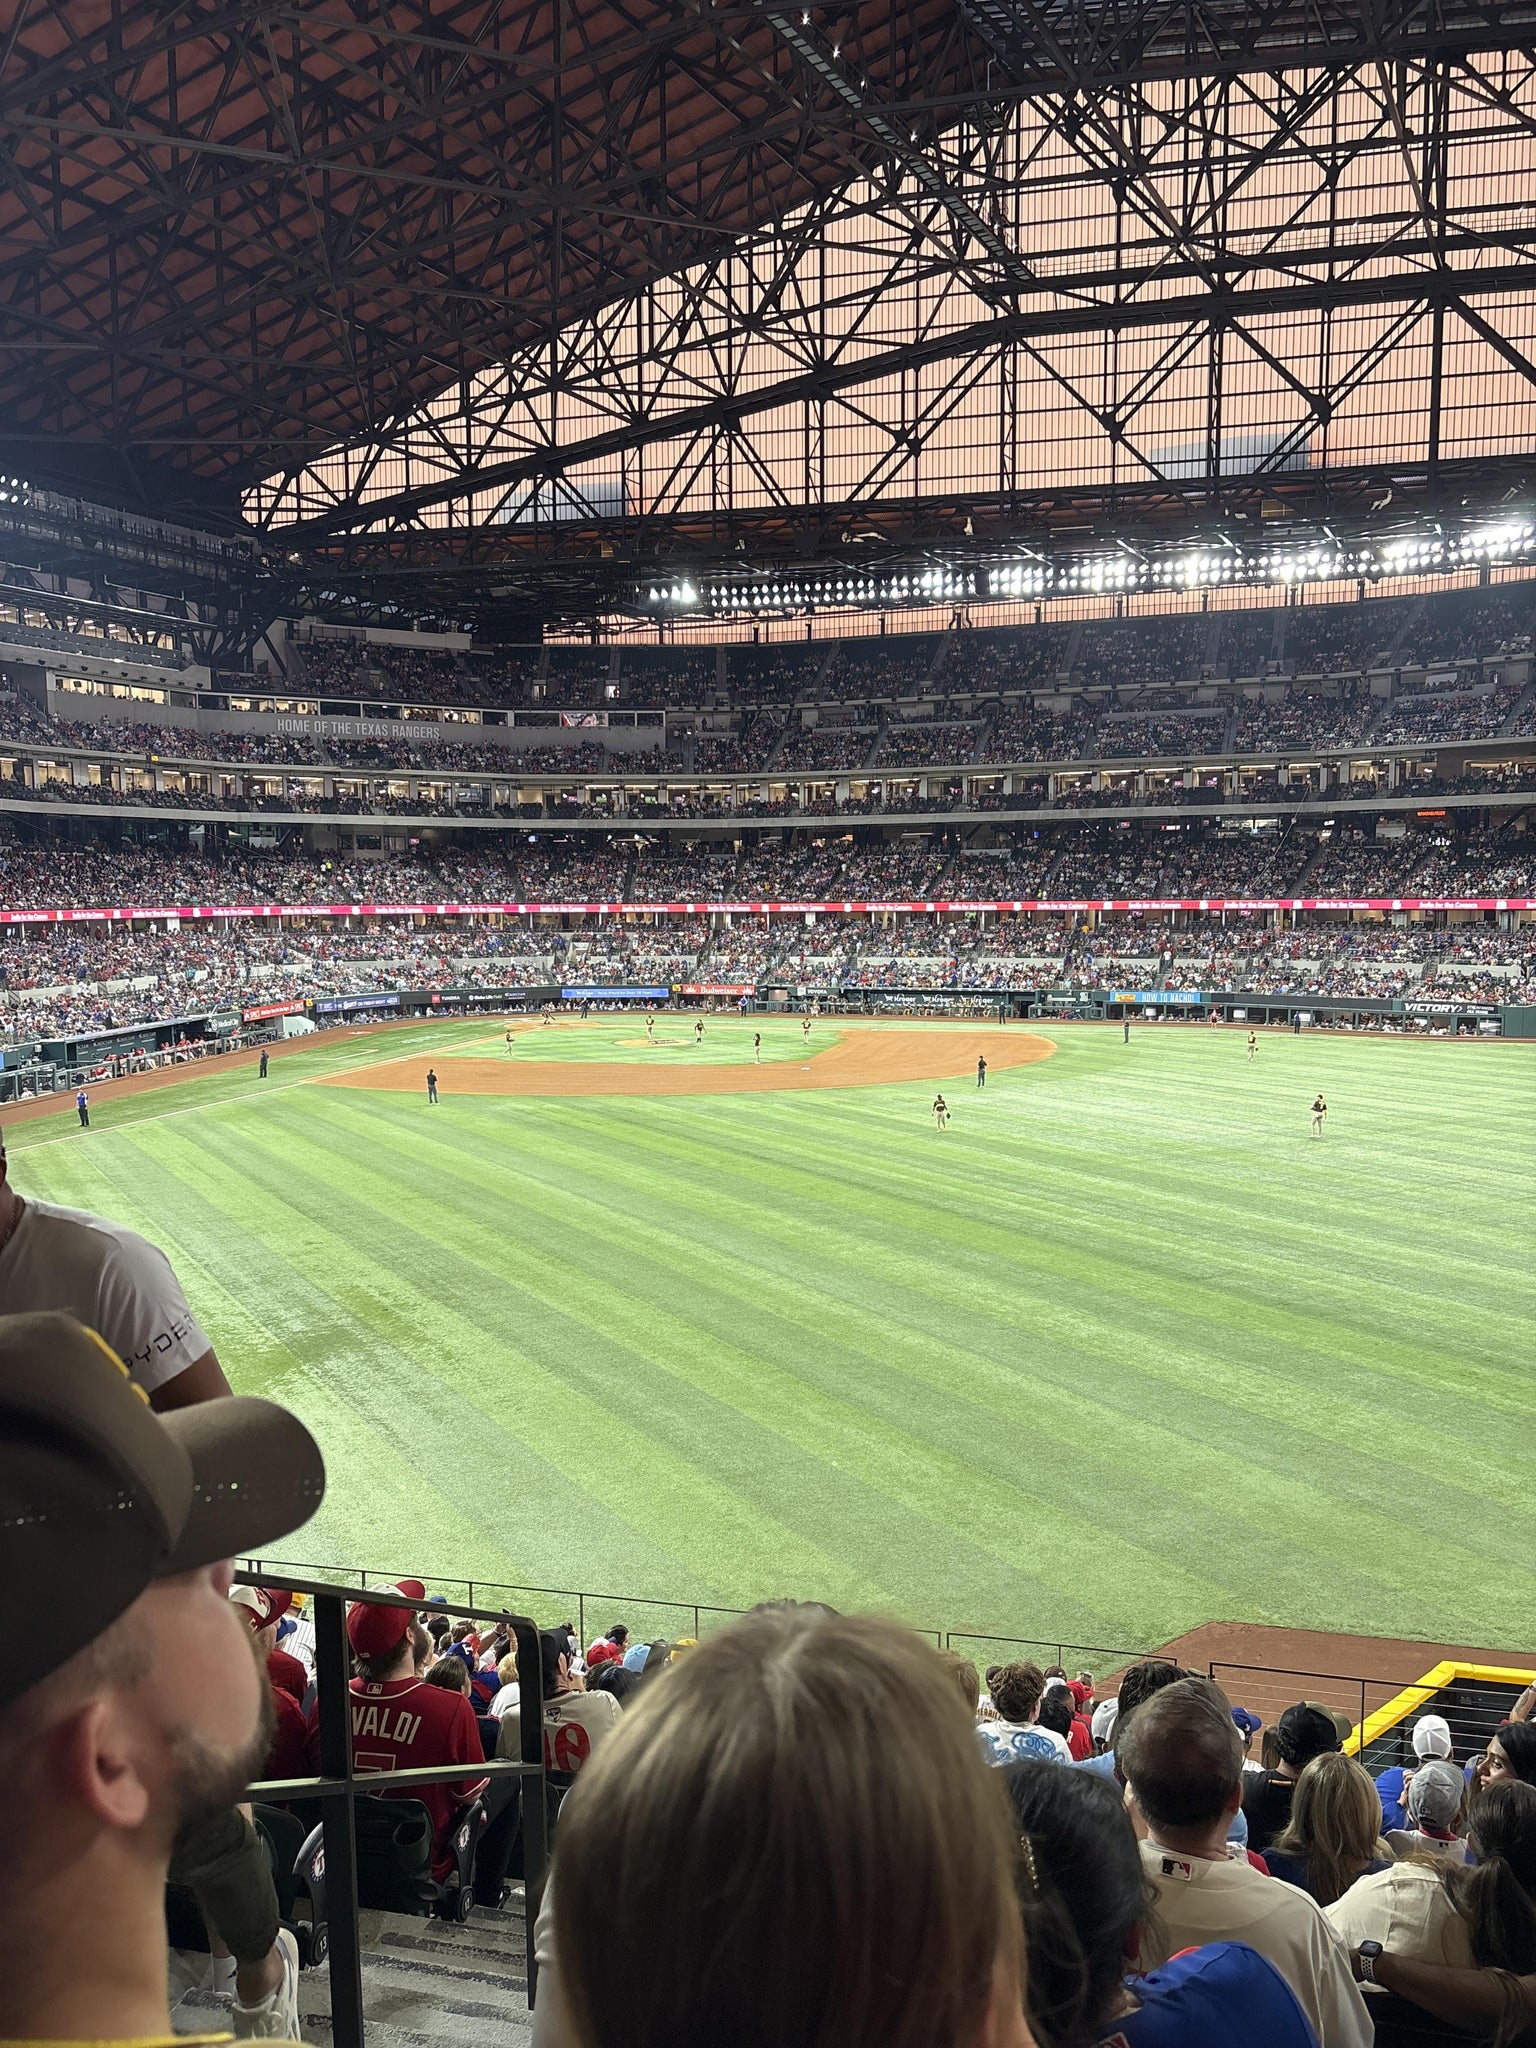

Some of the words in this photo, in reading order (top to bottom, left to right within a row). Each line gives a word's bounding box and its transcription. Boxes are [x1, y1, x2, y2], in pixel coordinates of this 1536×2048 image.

[277, 719, 310, 732] HOME
[314, 720, 328, 733] OF
[331, 722, 352, 734] THE
[355, 723, 388, 736] TEXAS
[392, 725, 440, 738] RANGERS
[701, 986, 738, 994] Budweiser
[894, 994, 916, 1004] Kroger
[1160, 993, 1168, 1001] TO
[1171, 993, 1195, 1002] NACHO!
[1404, 1003, 1458, 1013] VICTORY
[352, 1706, 422, 1745] VALDI
[319, 1936, 328, 1952] 13
